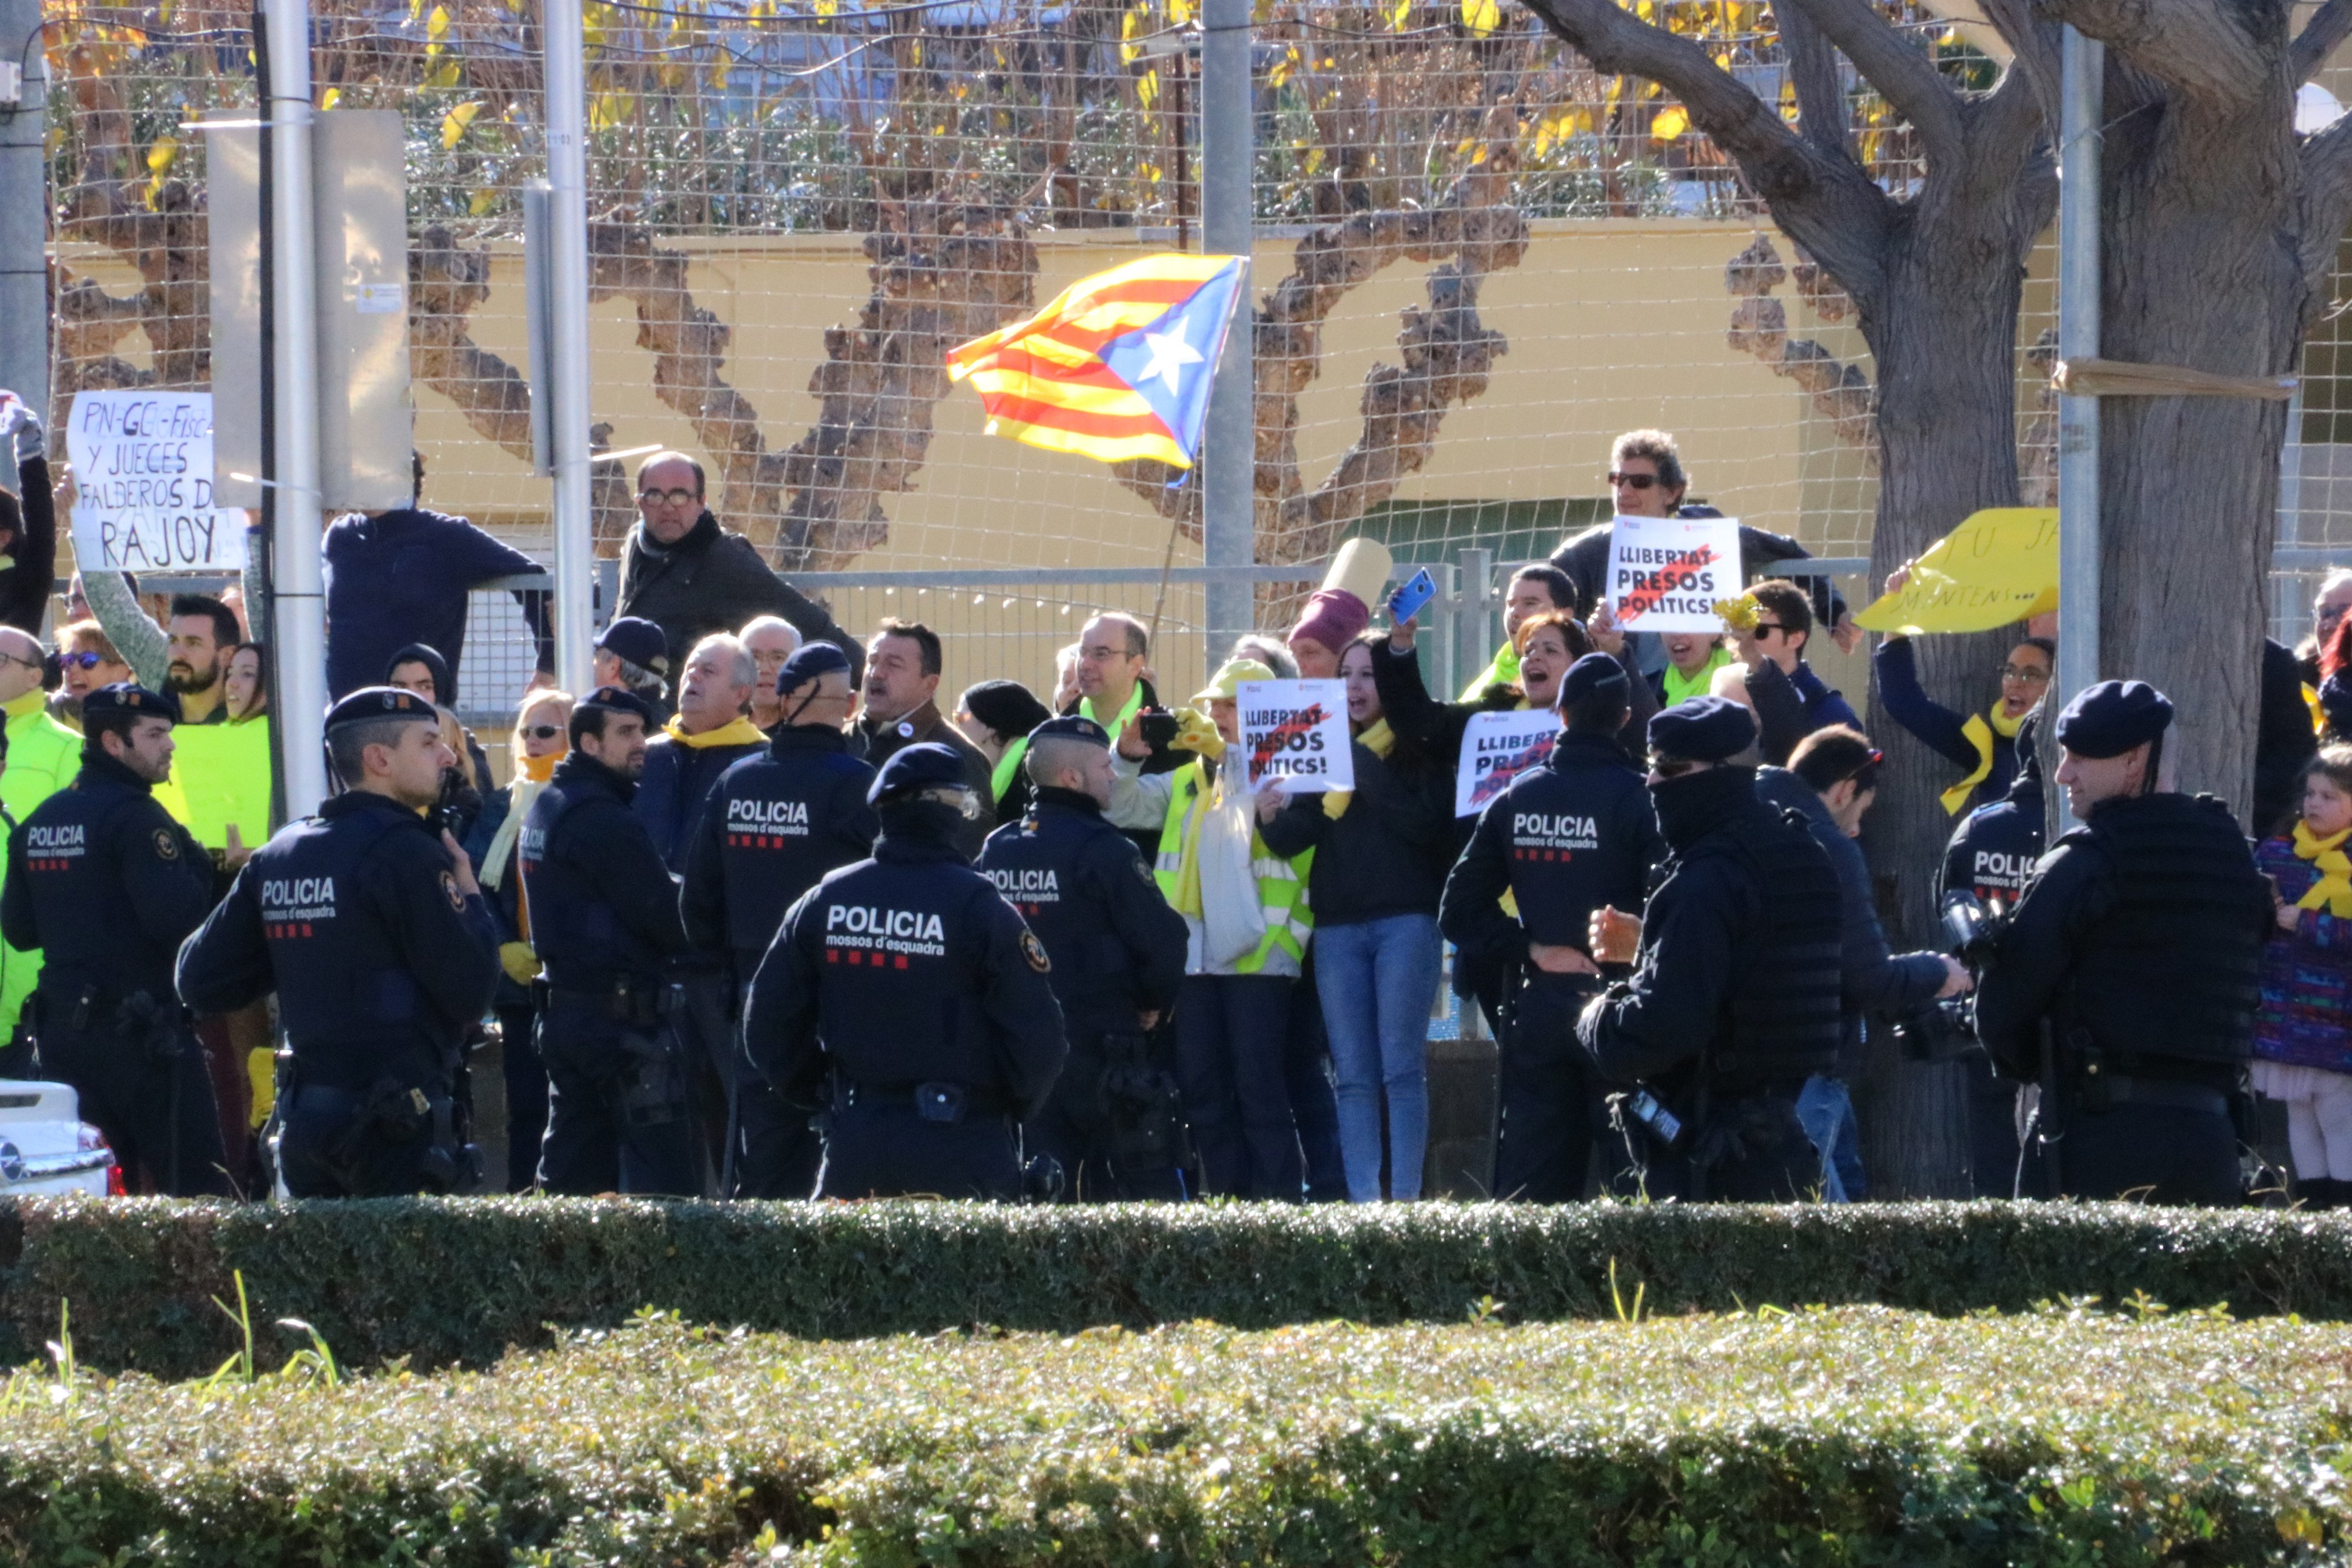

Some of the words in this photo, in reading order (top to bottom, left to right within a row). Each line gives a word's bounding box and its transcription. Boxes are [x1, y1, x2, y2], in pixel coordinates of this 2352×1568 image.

[88, 445, 101, 473] Y
[108, 442, 188, 475] JUECES
[80, 478, 183, 509] FALDEROS
[101, 515, 215, 568] RAJOY
[1944, 526, 1996, 563] TU
[1619, 546, 1712, 566] LLIBERTAT
[1618, 569, 1714, 592] PRESOS
[1245, 708, 1322, 727] LLIBERTAT
[1246, 731, 1325, 753] PRESOS
[727, 799, 808, 824] POLICIA
[28, 824, 83, 847] POLICIA
[727, 823, 759, 833] mossos
[1514, 813, 1598, 838] POLICIA
[1514, 837, 1545, 846] mossos
[262, 877, 335, 906] POLICIA
[1975, 875, 2009, 887] mossos
[827, 905, 944, 941] POLICIA
[826, 935, 873, 948] mossos
